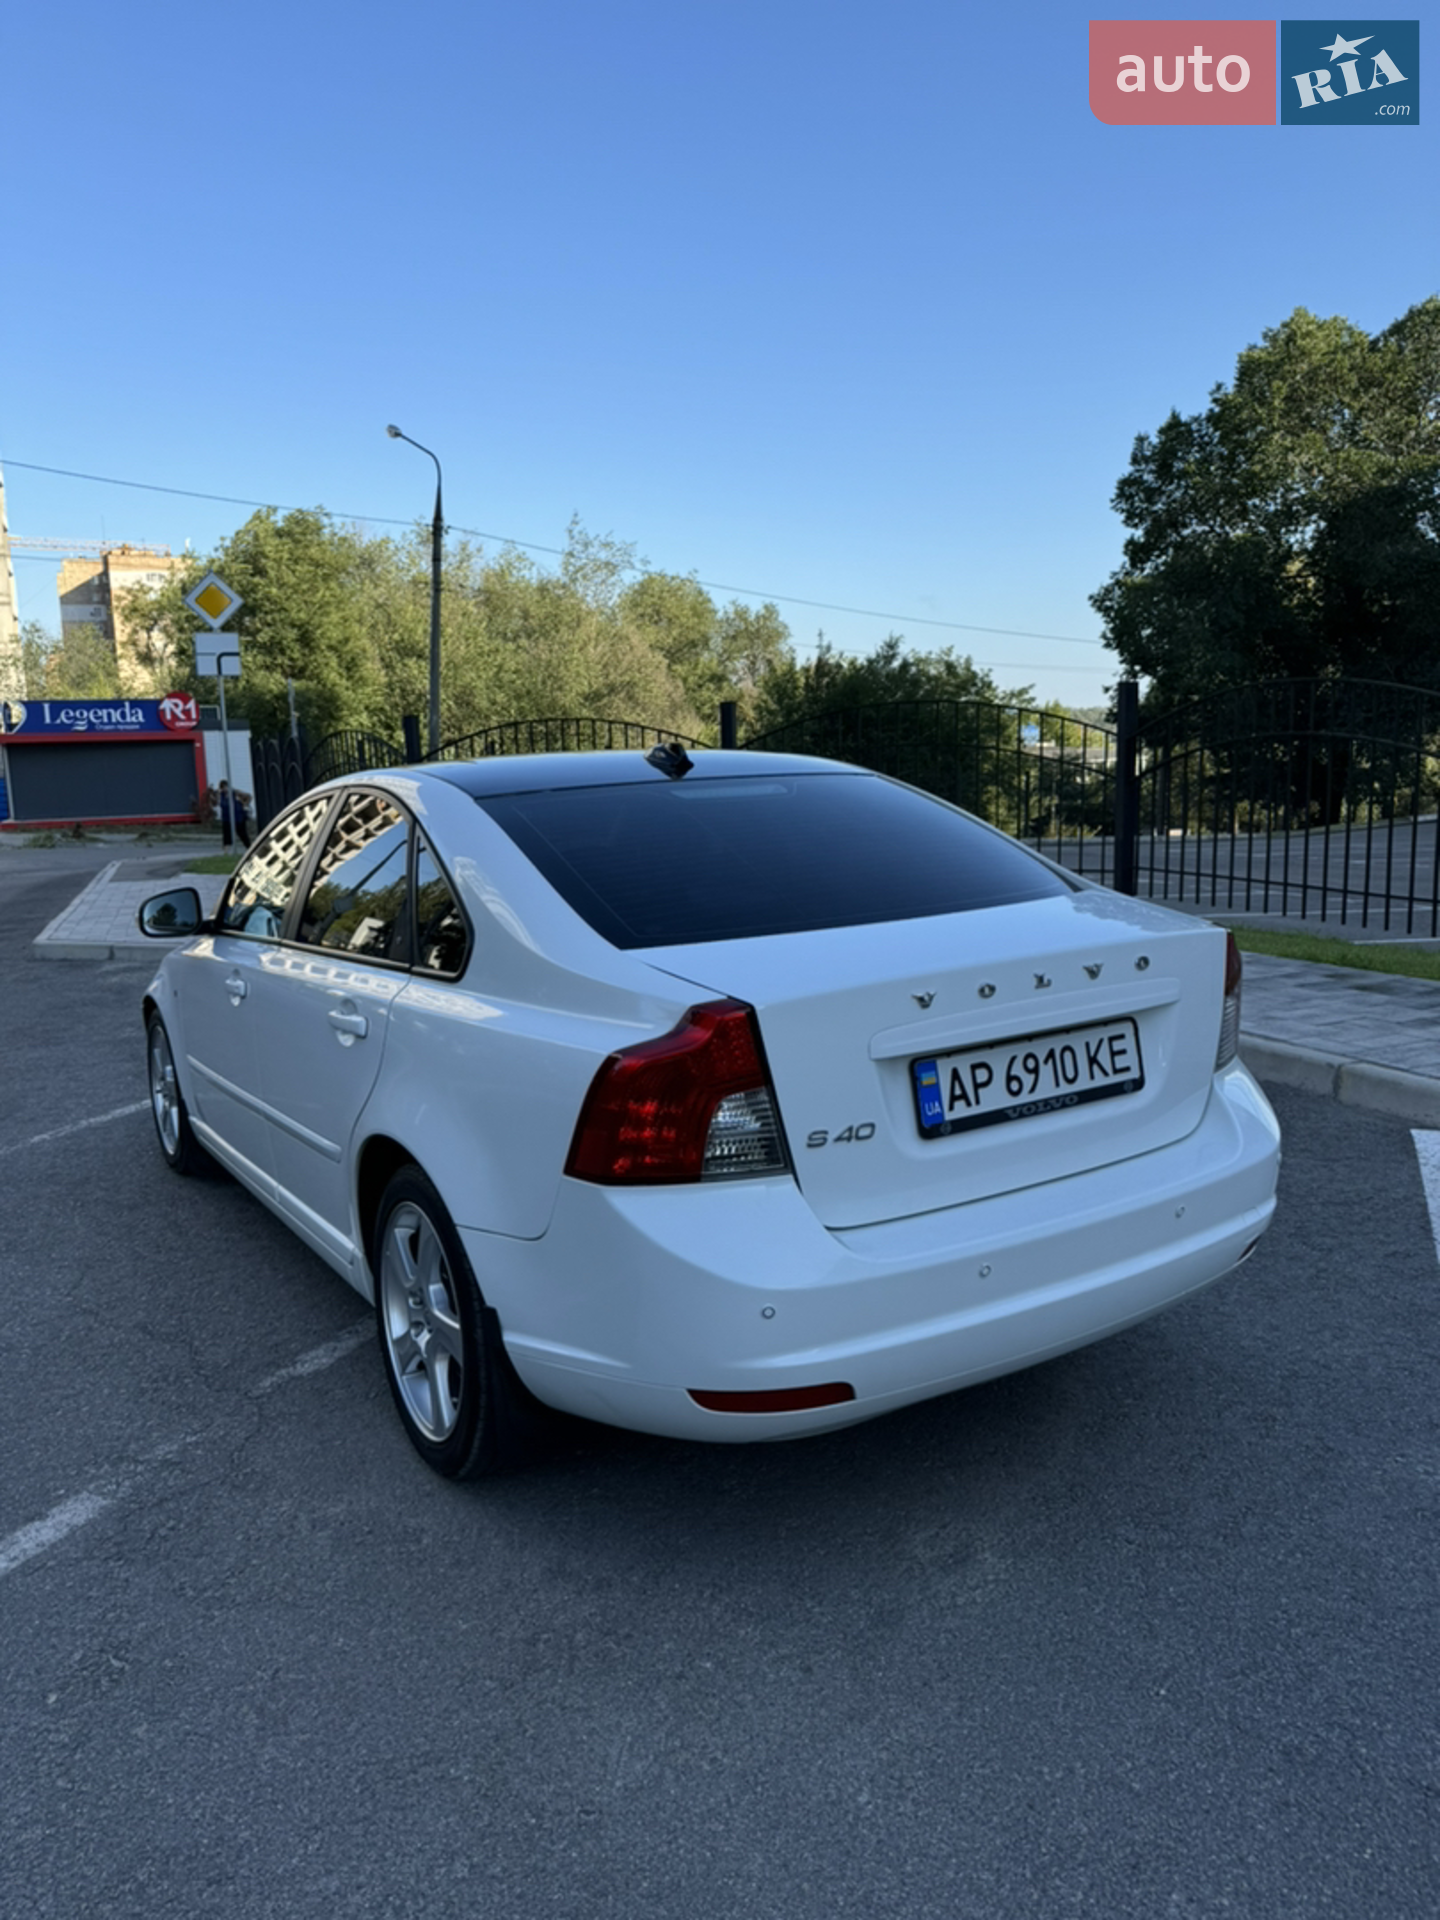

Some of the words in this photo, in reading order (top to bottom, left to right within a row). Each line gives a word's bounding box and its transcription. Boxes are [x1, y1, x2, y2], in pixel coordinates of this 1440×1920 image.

[43, 701, 145, 731] Legenda
[911, 955, 1150, 1009] VOLVO
[948, 1061, 994, 1112] AP
[1005, 1044, 1079, 1098] 6910
[1085, 1033, 1131, 1081] KE
[925, 1101, 942, 1116] UA
[1004, 1094, 1079, 1119] VOLVO
